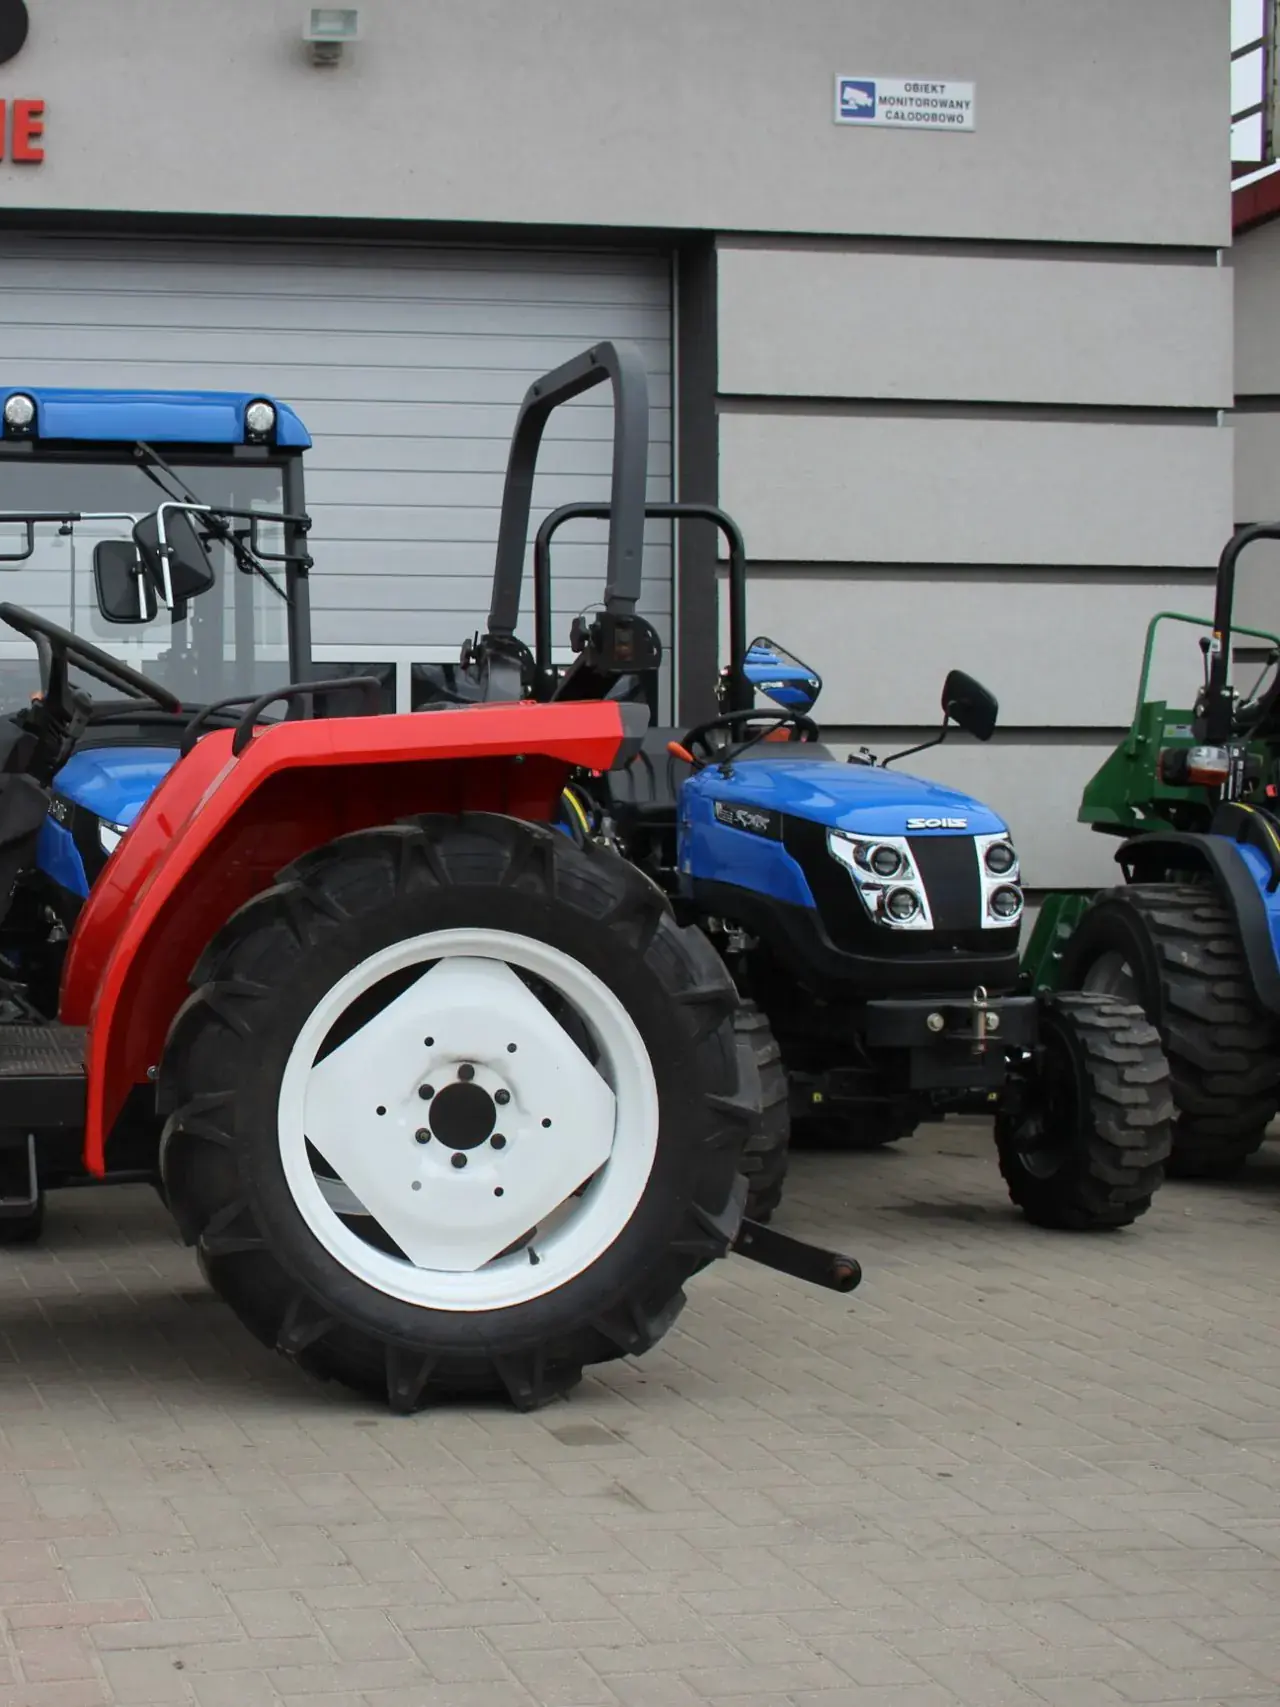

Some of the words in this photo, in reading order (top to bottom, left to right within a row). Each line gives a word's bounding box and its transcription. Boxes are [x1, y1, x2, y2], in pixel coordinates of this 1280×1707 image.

[904, 83, 946, 94] OBIEKT
[878, 96, 971, 110] MONITOROWANY
[885, 110, 964, 124] CAŁODOBOWO
